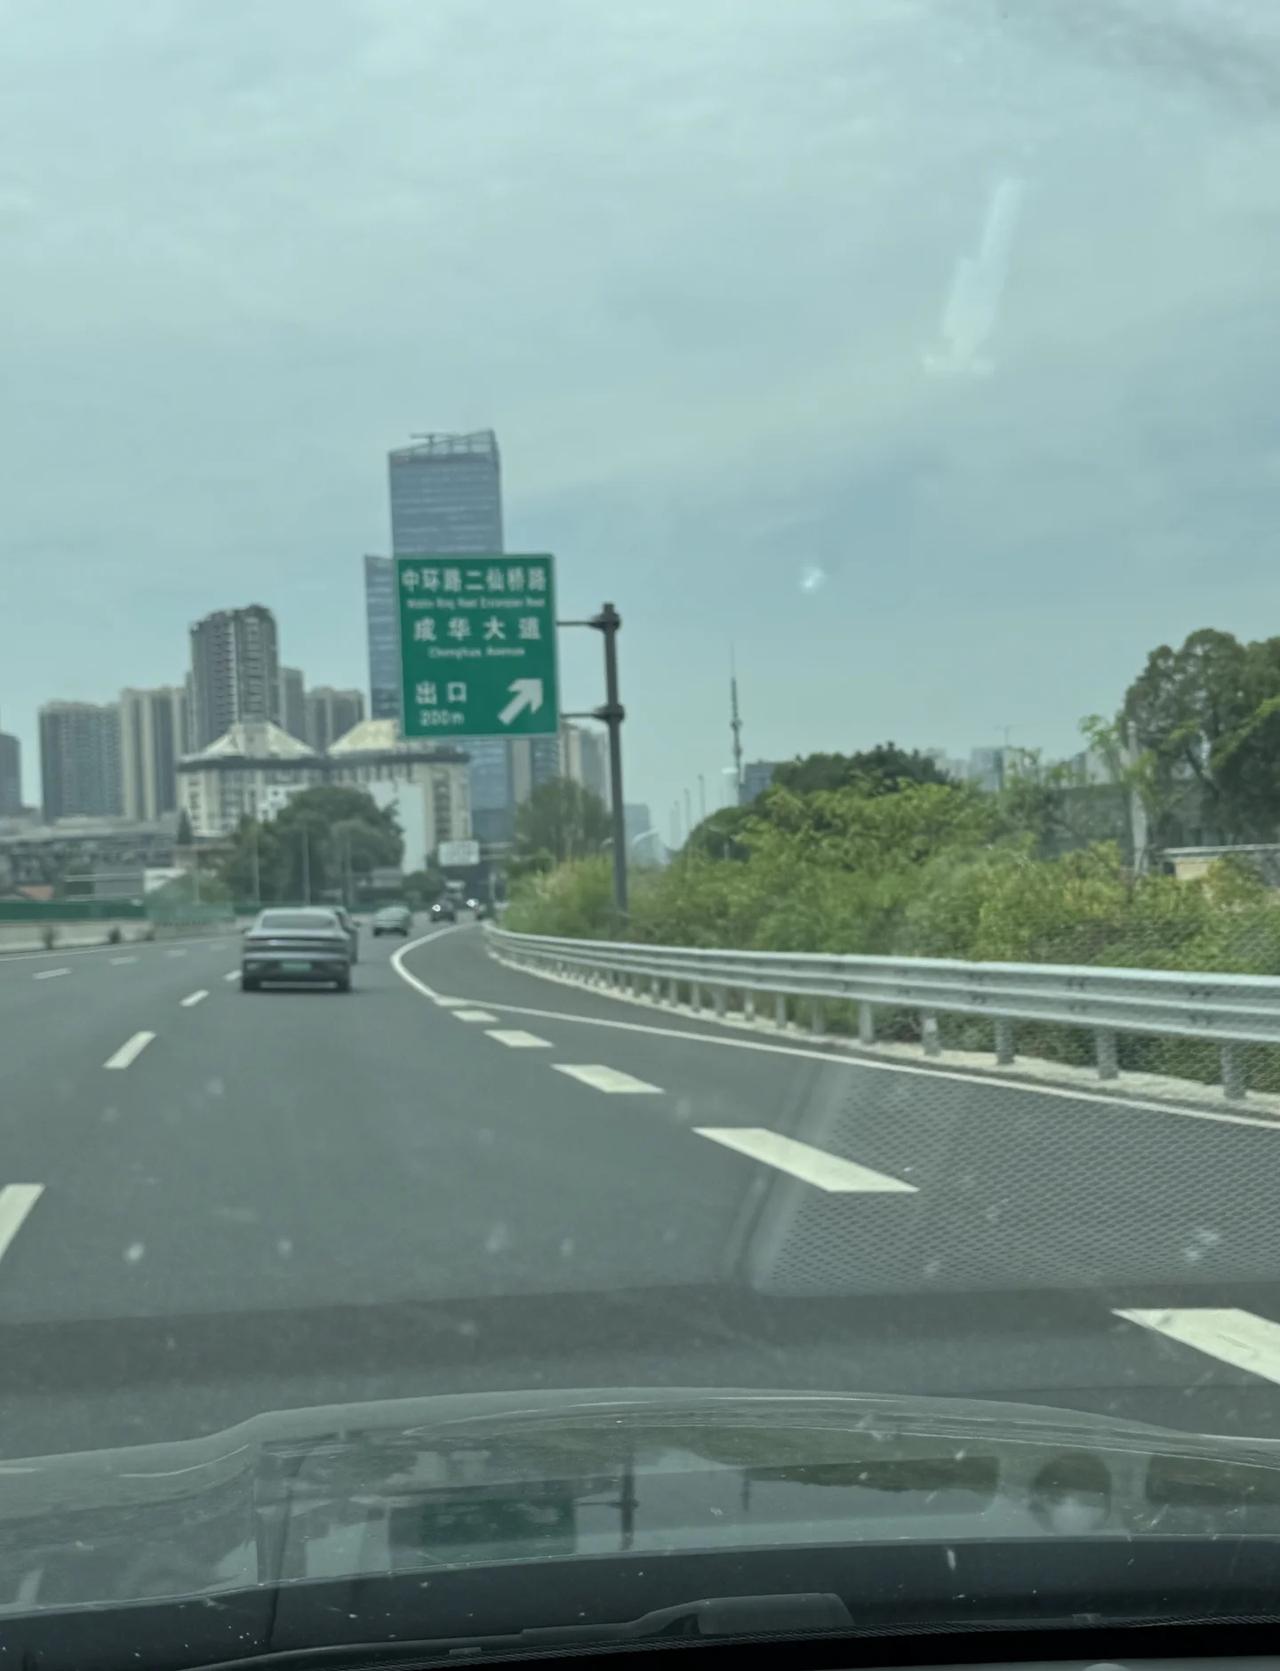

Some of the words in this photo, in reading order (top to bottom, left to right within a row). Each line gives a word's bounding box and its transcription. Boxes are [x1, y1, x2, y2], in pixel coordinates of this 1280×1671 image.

[413, 616, 542, 641] 成华大道
[415, 680, 467, 705] 出口
